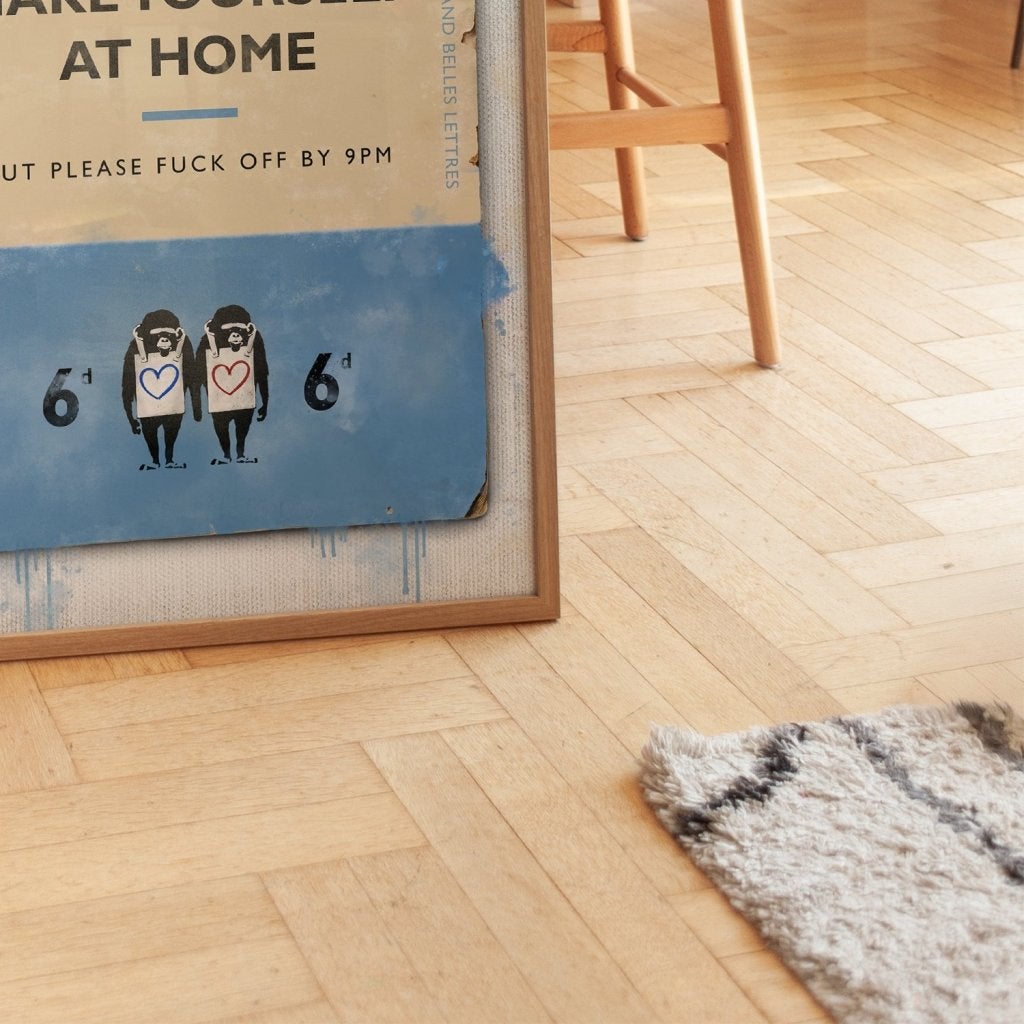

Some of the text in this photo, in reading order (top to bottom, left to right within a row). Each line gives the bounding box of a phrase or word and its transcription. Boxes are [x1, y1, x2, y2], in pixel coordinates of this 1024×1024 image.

[59, 32, 316, 80] AT HOME
[442, 43, 457, 105] BELLES
[51, 158, 142, 179] PLEASE
[157, 154, 225, 175] FUCK
[240, 151, 287, 171] OFF
[301, 149, 331, 167] BY
[345, 147, 392, 165] 9PM
[444, 112, 459, 190] LETTRES
